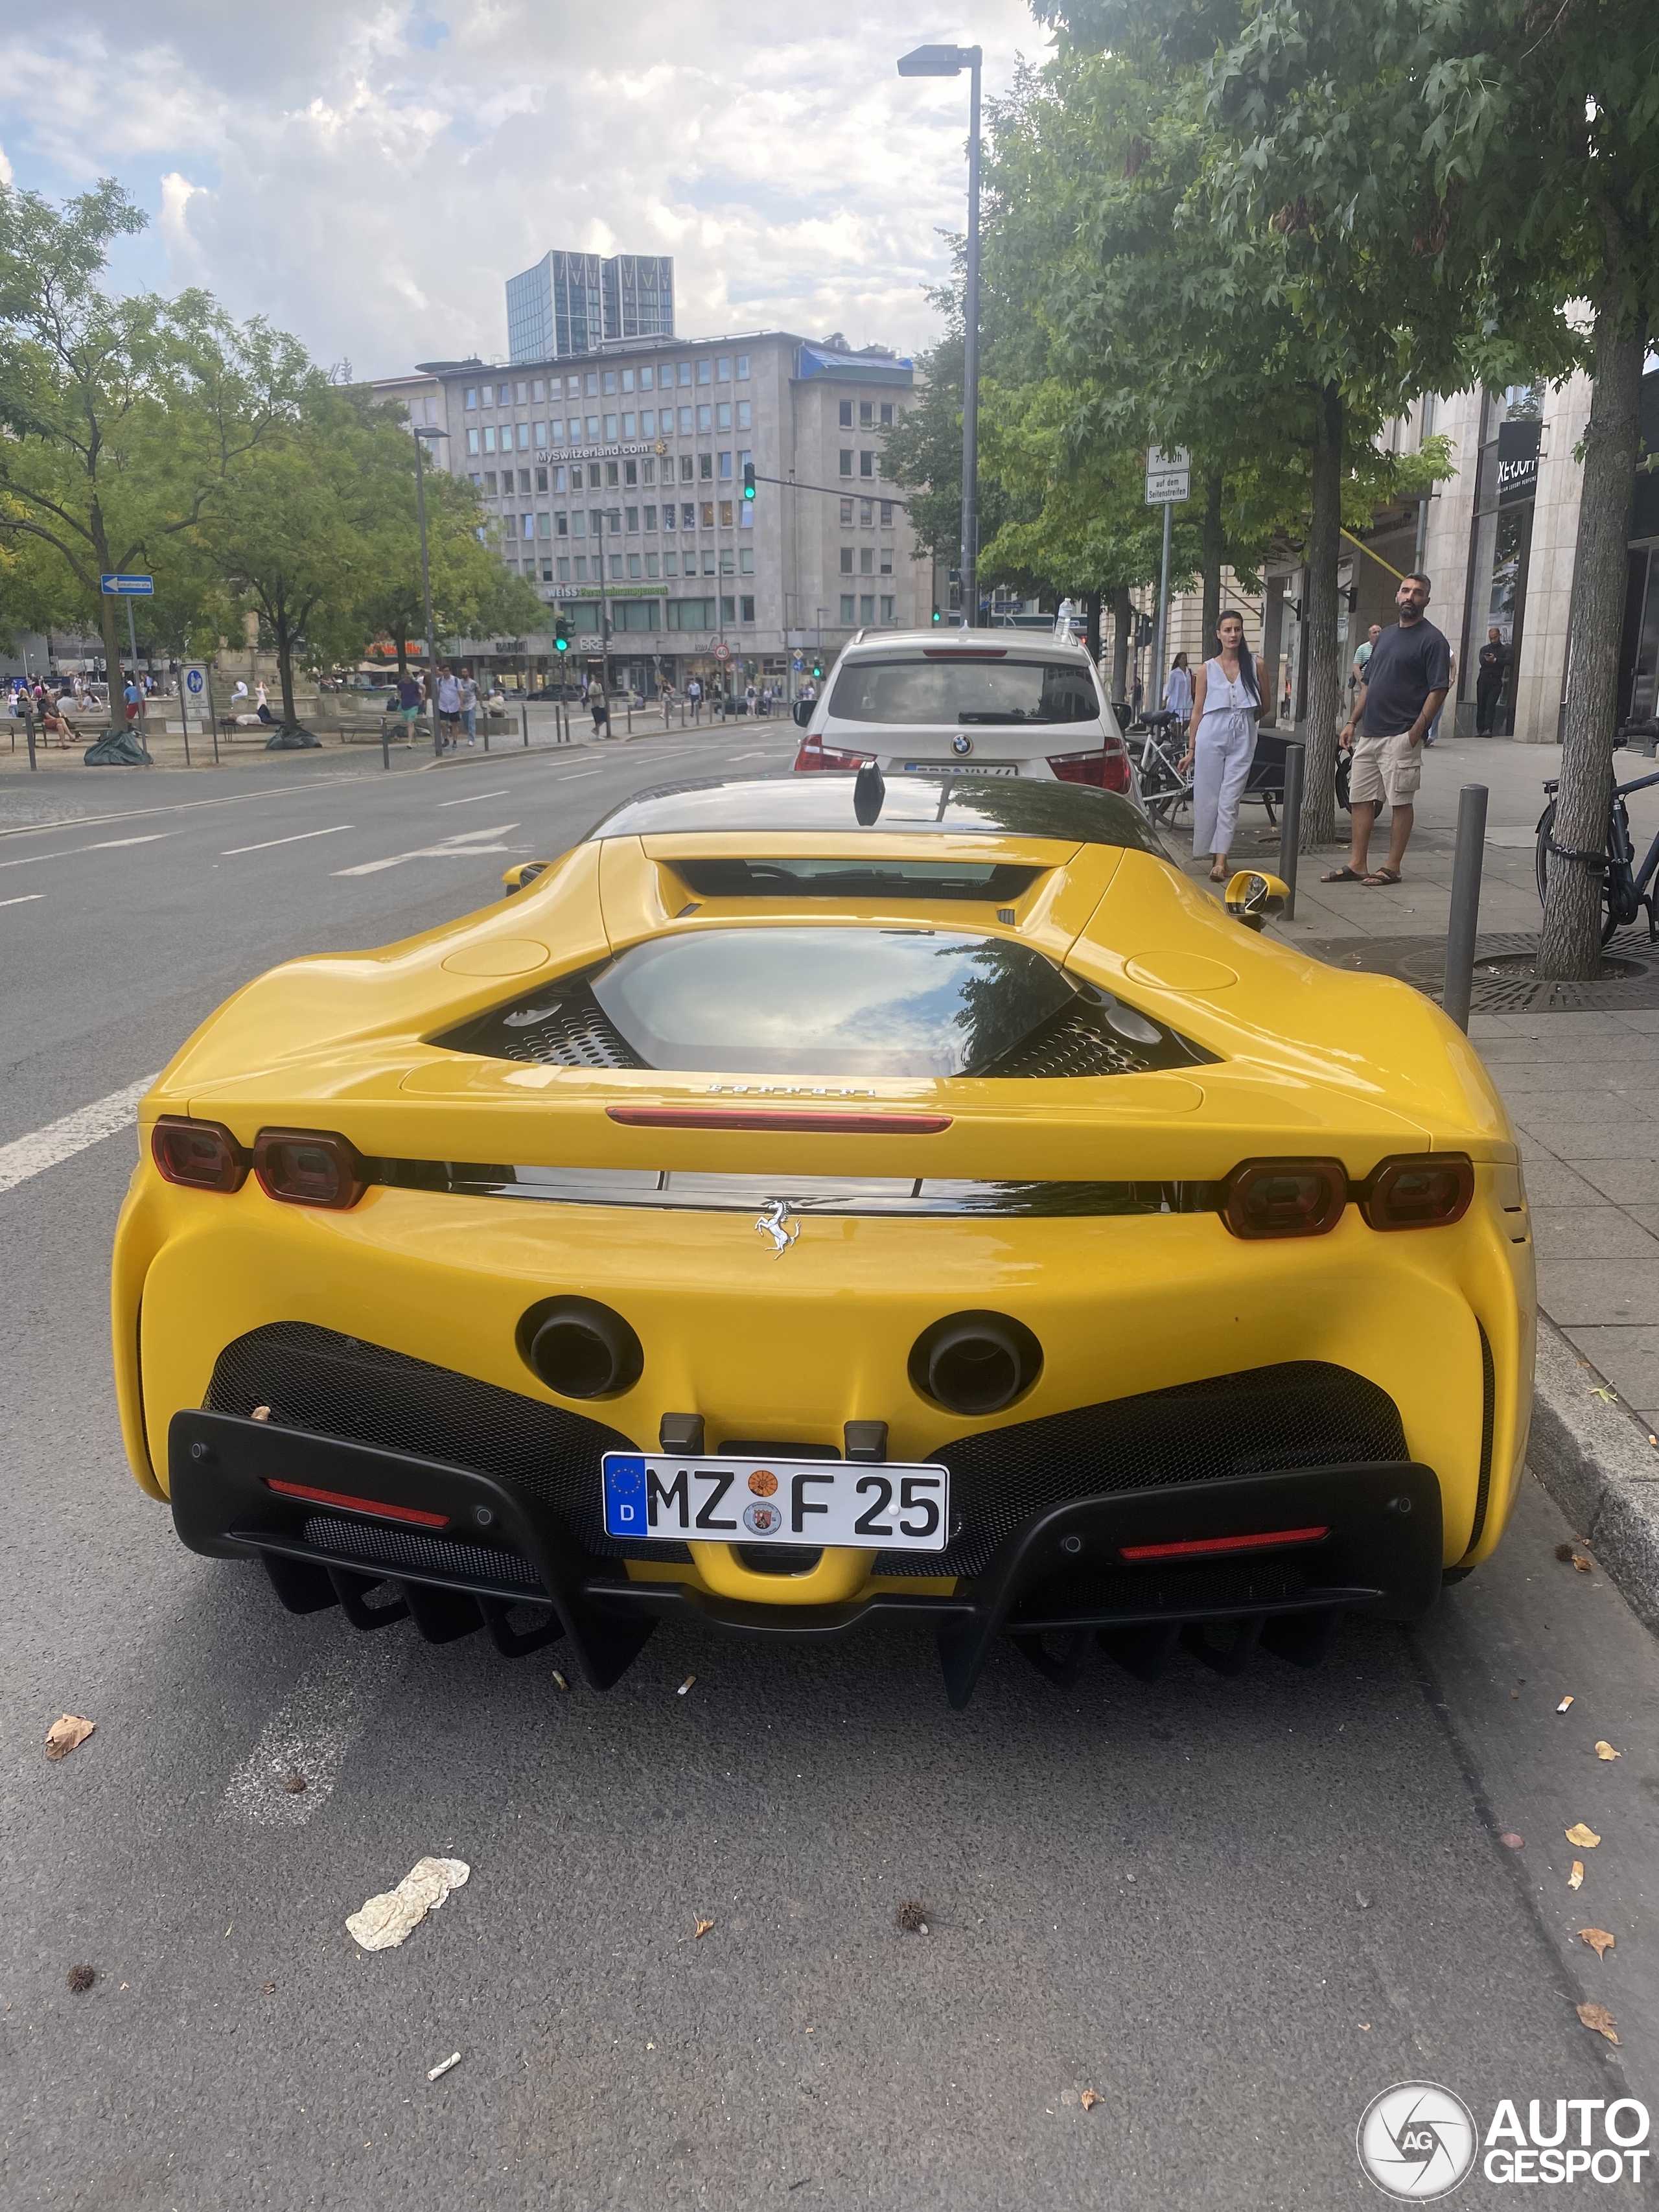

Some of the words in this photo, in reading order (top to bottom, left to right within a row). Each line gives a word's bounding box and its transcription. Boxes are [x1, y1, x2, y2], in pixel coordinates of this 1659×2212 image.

[537, 443, 649, 463] MySwitzerland.com
[1156, 479, 1165, 487] auf
[1167, 478, 1179, 486] dem
[1522, 475, 1537, 485] PERFUME
[1149, 487, 1186, 498] Seitenstreifen
[548, 588, 577, 597] WEISS
[620, 1504, 634, 1521] D
[647, 1467, 737, 1530] MZ
[791, 1474, 834, 1532] F
[854, 1476, 940, 1537] 25
